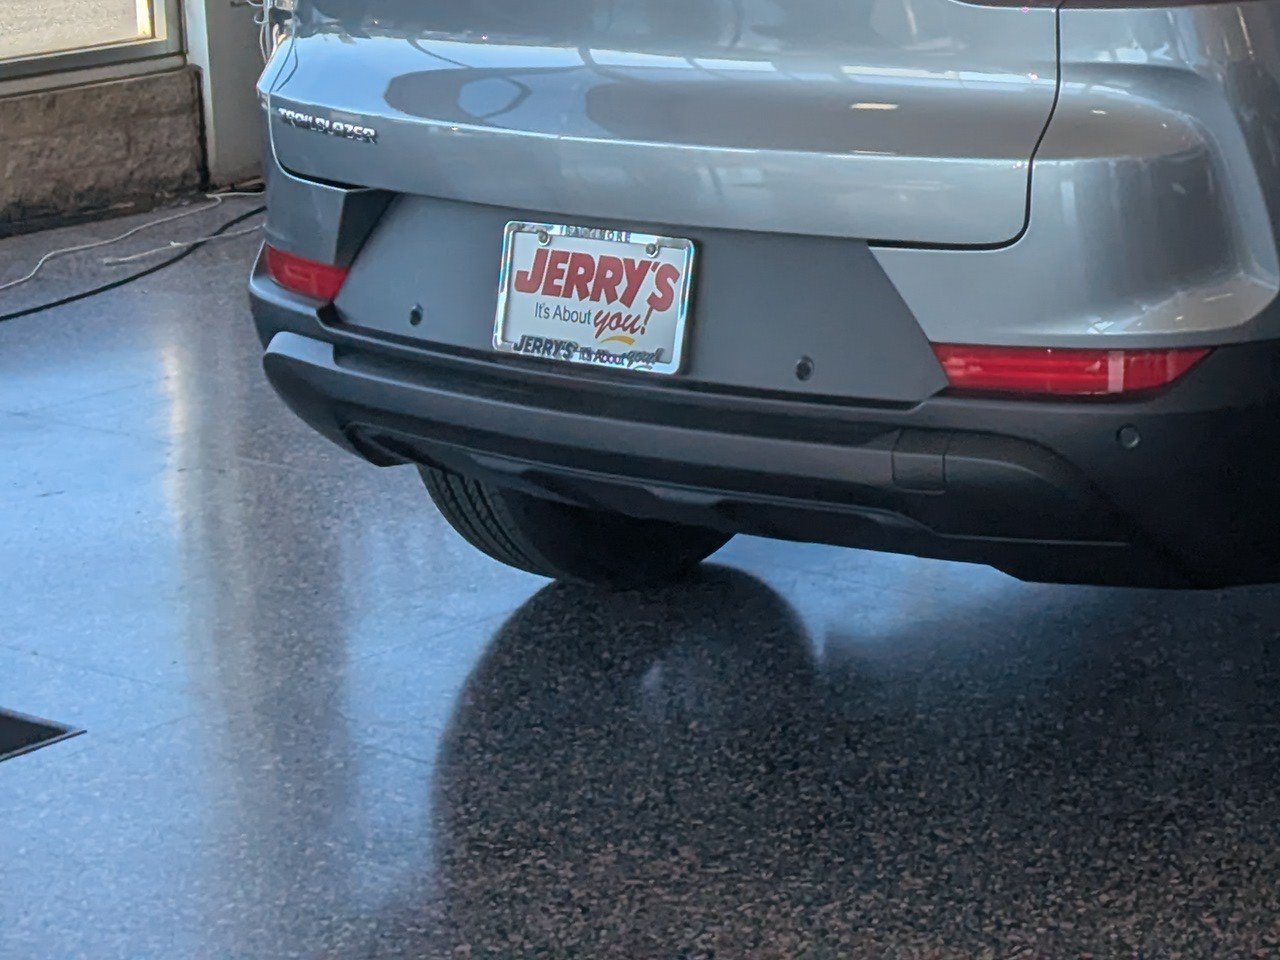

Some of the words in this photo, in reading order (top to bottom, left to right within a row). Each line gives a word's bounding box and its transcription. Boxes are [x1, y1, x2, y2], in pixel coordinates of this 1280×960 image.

[514, 248, 680, 312] JERRY'S
[535, 302, 550, 319] It's
[552, 305, 592, 325] About
[594, 306, 652, 338] you!
[513, 334, 577, 359] JERRY'S
